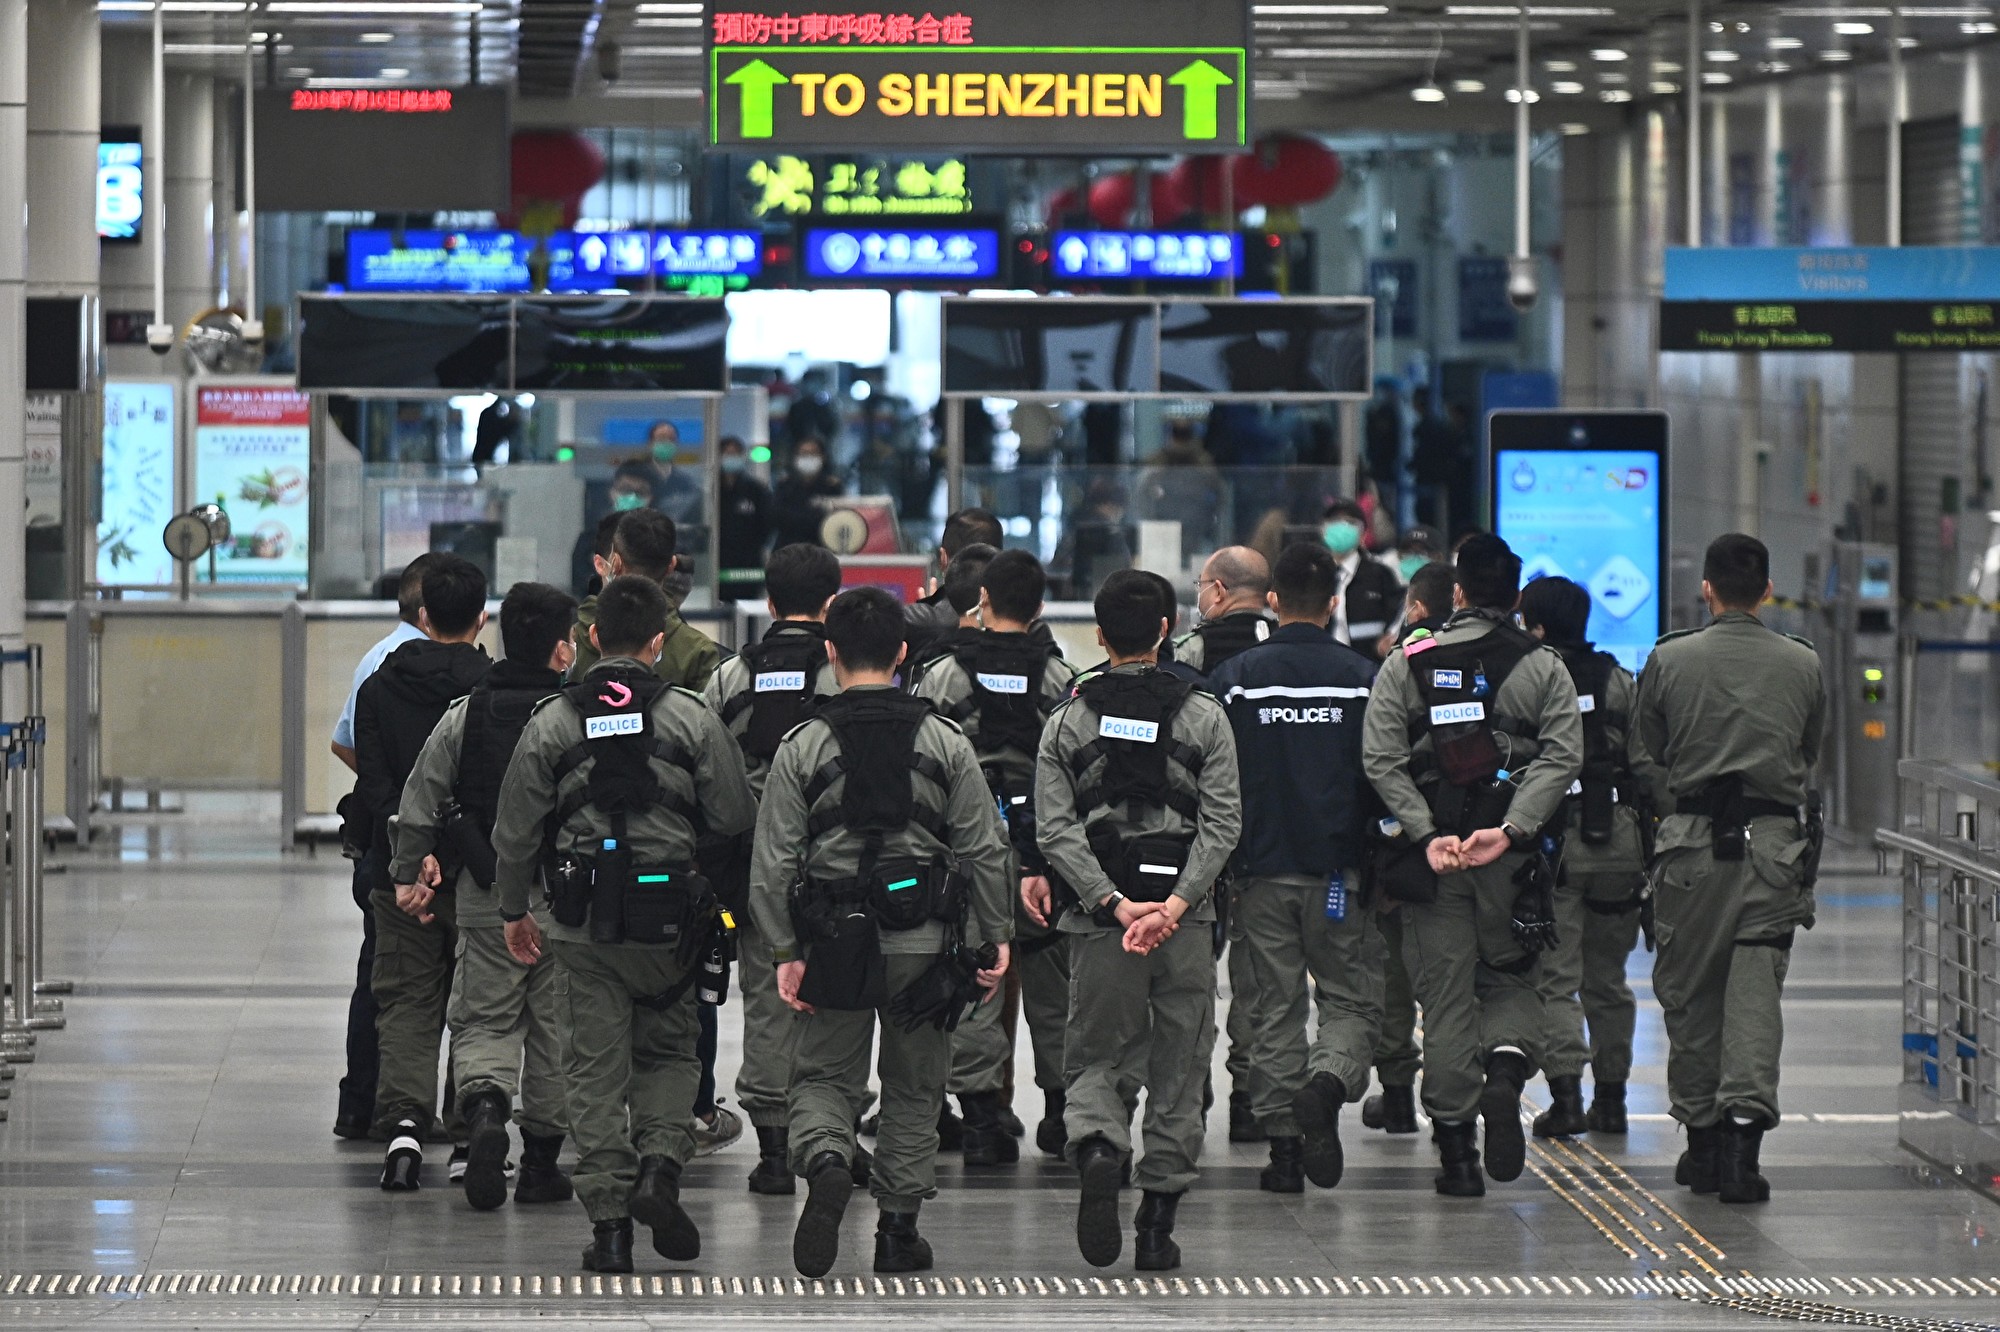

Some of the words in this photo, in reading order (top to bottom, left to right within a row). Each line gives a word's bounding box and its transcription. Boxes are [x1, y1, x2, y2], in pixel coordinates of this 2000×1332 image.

[713, 11, 974, 45] 預防中東呼吸綜合症
[791, 72, 866, 117] TO
[876, 72, 1163, 117] SHENZHEN
[1799, 273, 1869, 290] Visitors
[758, 677, 801, 689] POLICE
[980, 677, 1024, 689] POLICE
[1435, 706, 1481, 721] POLICE
[590, 718, 639, 734] POLICE
[1105, 722, 1154, 739] POLICE
